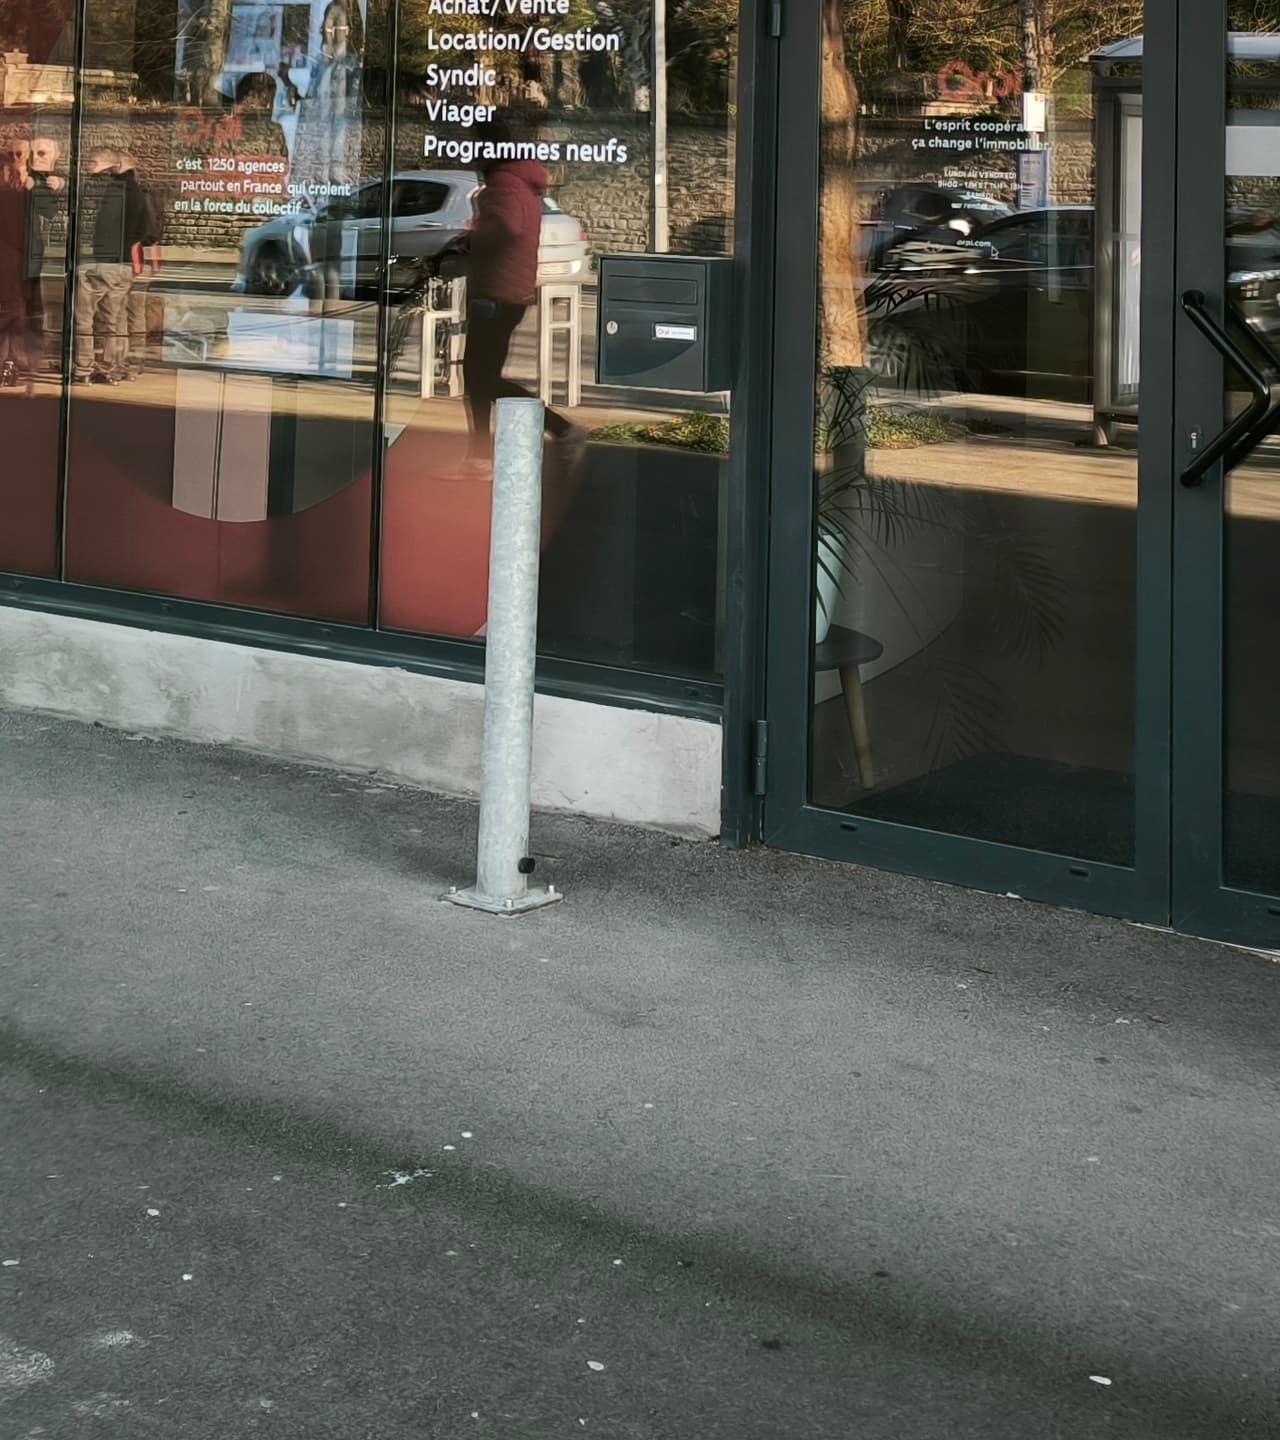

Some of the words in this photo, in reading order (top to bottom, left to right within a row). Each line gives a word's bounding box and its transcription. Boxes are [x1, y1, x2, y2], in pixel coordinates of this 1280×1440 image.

[427, 26, 619, 53] Location/Gestion
[426, 64, 496, 90] Syndic
[426, 100, 496, 127] Viager
[924, 119, 970, 133] L'esprit
[424, 135, 560, 163] Programmes
[566, 138, 628, 163] neufs
[912, 140, 926, 151] ça
[928, 137, 972, 152] change
[176, 157, 202, 171] c'est
[208, 158, 235, 172] 1250
[238, 160, 285, 175] agences
[180, 180, 224, 196] partout
[227, 182, 241, 192] en
[243, 180, 282, 194] France
[287, 182, 306, 197] qui
[308, 183, 351, 196] croient
[174, 200, 188, 211] en
[190, 198, 201, 211] la
[204, 198, 233, 213] force
[235, 199, 250, 213] du
[252, 200, 302, 215] collectif
